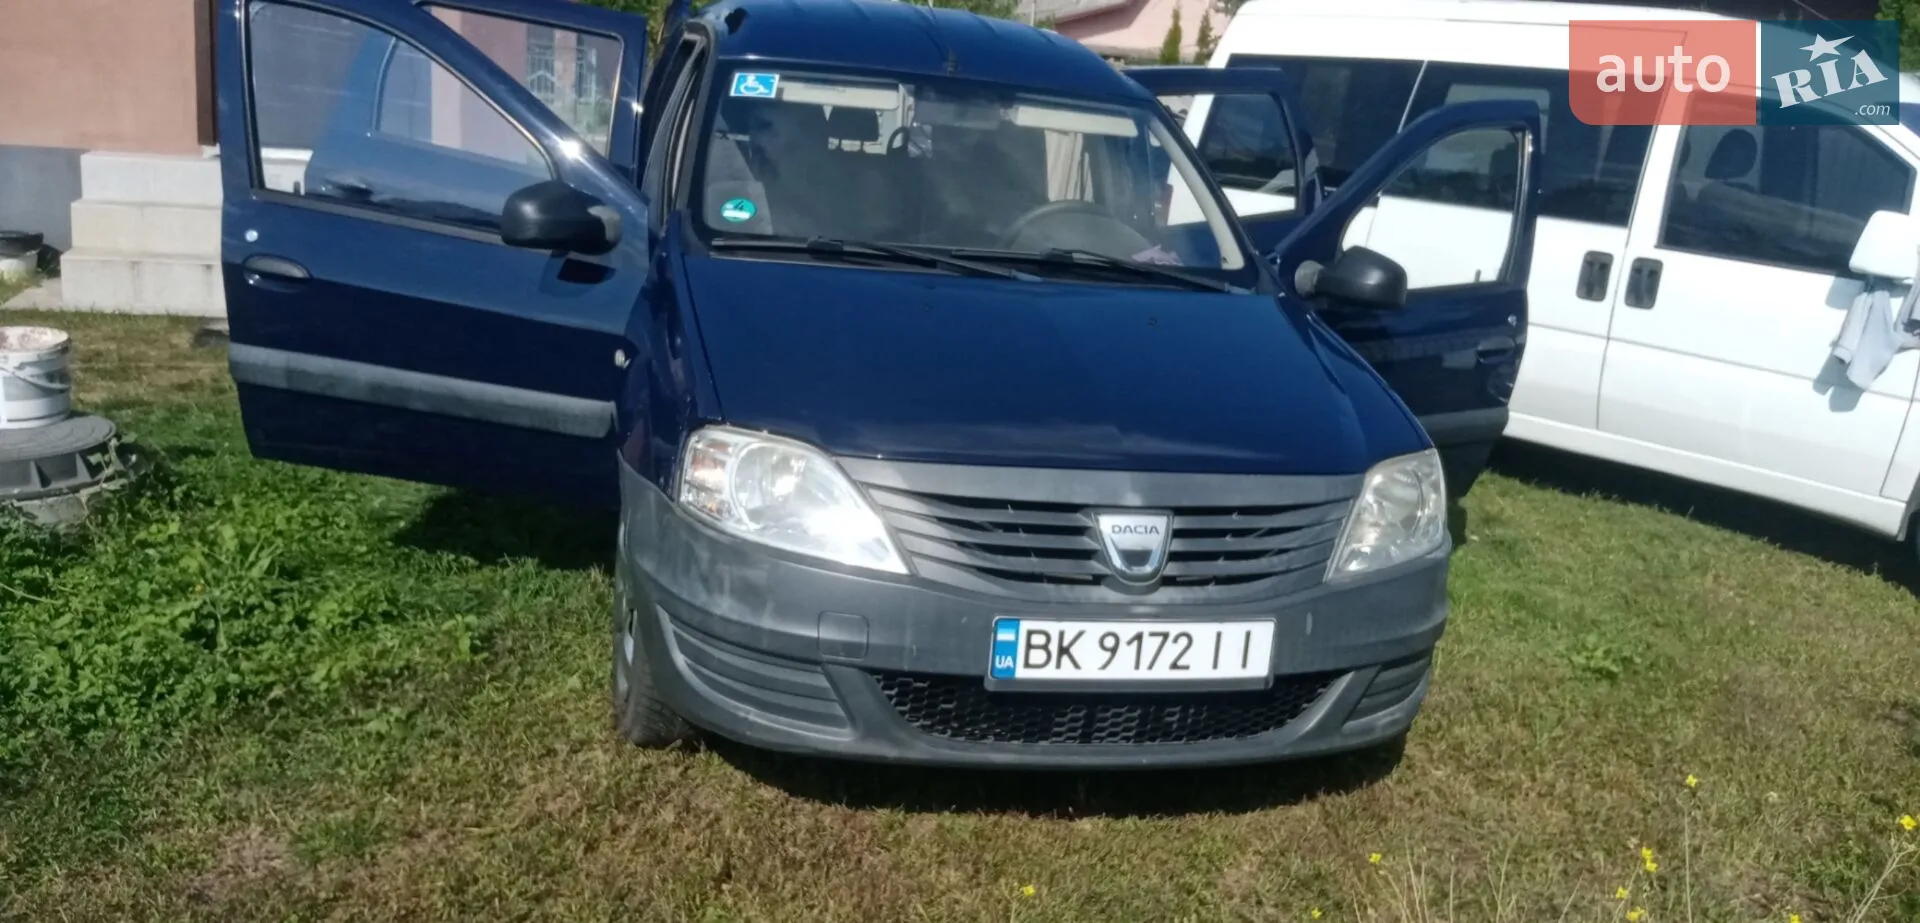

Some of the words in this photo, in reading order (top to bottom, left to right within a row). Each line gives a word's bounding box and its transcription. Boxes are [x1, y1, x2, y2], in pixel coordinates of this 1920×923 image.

[1111, 524, 1160, 535] DACIA
[1023, 629, 1086, 670] BK
[1097, 630, 1194, 670] 9172
[995, 655, 1013, 669] UA
